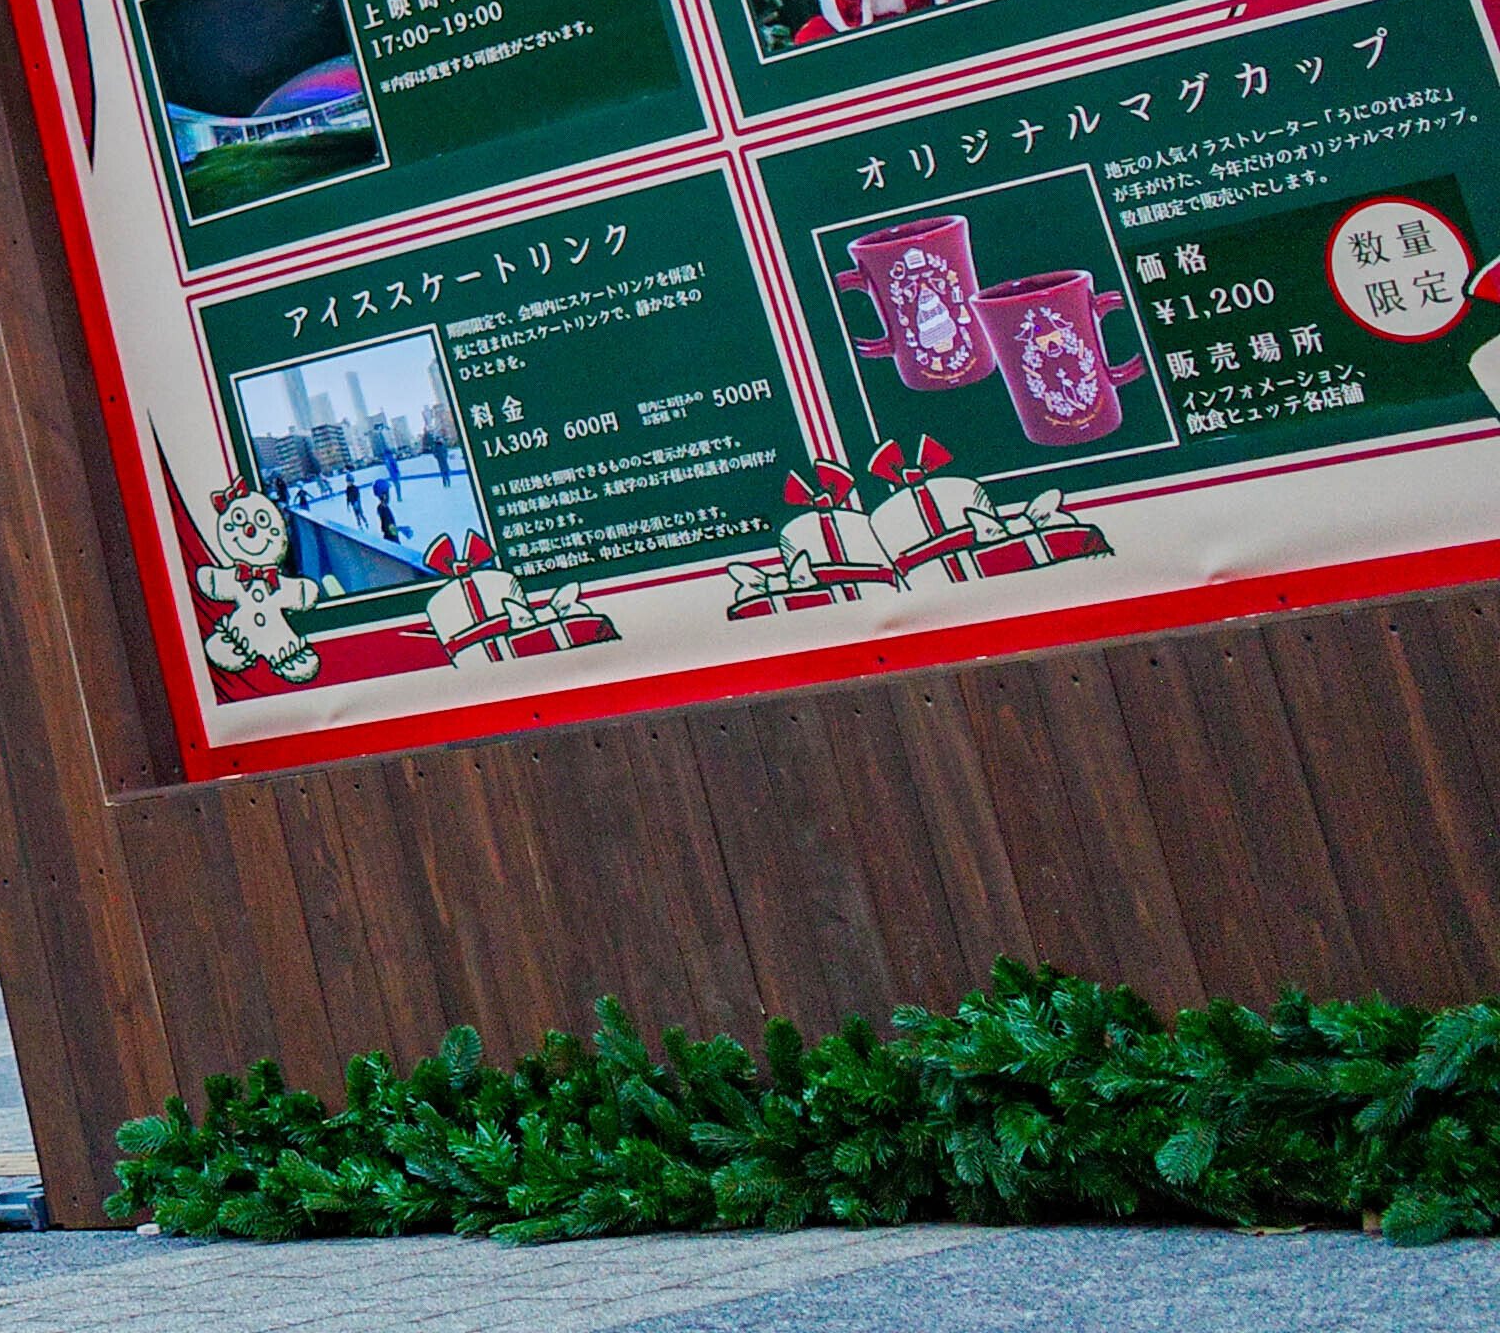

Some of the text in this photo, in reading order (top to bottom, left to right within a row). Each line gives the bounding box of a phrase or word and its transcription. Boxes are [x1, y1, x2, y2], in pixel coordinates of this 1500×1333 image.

[371, 2, 502, 58] 17:00~19:00
[380, 21, 593, 93] ※内容は変更する可能性がございます。
[857, 27, 1387, 190] オリジナルマグカップ
[1104, 88, 1453, 179] 地元の人気イラストレーター「うにのれおな」
[1112, 107, 1477, 202] が手がけた、今年だけのオリジナルマグカップ。
[1120, 170, 1327, 228] 数量限定で販売いたします。
[1137, 244, 1206, 283] 価格
[1348, 220, 1436, 269] 数量
[285, 225, 625, 337] アイススケートリンク
[1152, 279, 1273, 324] ¥1,200
[1365, 270, 1452, 317] 限定
[459, 356, 525, 380] ひとときを。
[1166, 324, 1322, 381] 販売場所
[470, 396, 524, 429] 料金
[713, 379, 771, 407] 500円
[1183, 365, 1365, 410] インフォメーション、
[1186, 382, 1364, 434] 飲食ヒュッテ各店舗
[483, 412, 618, 457] 1人30分 600円
